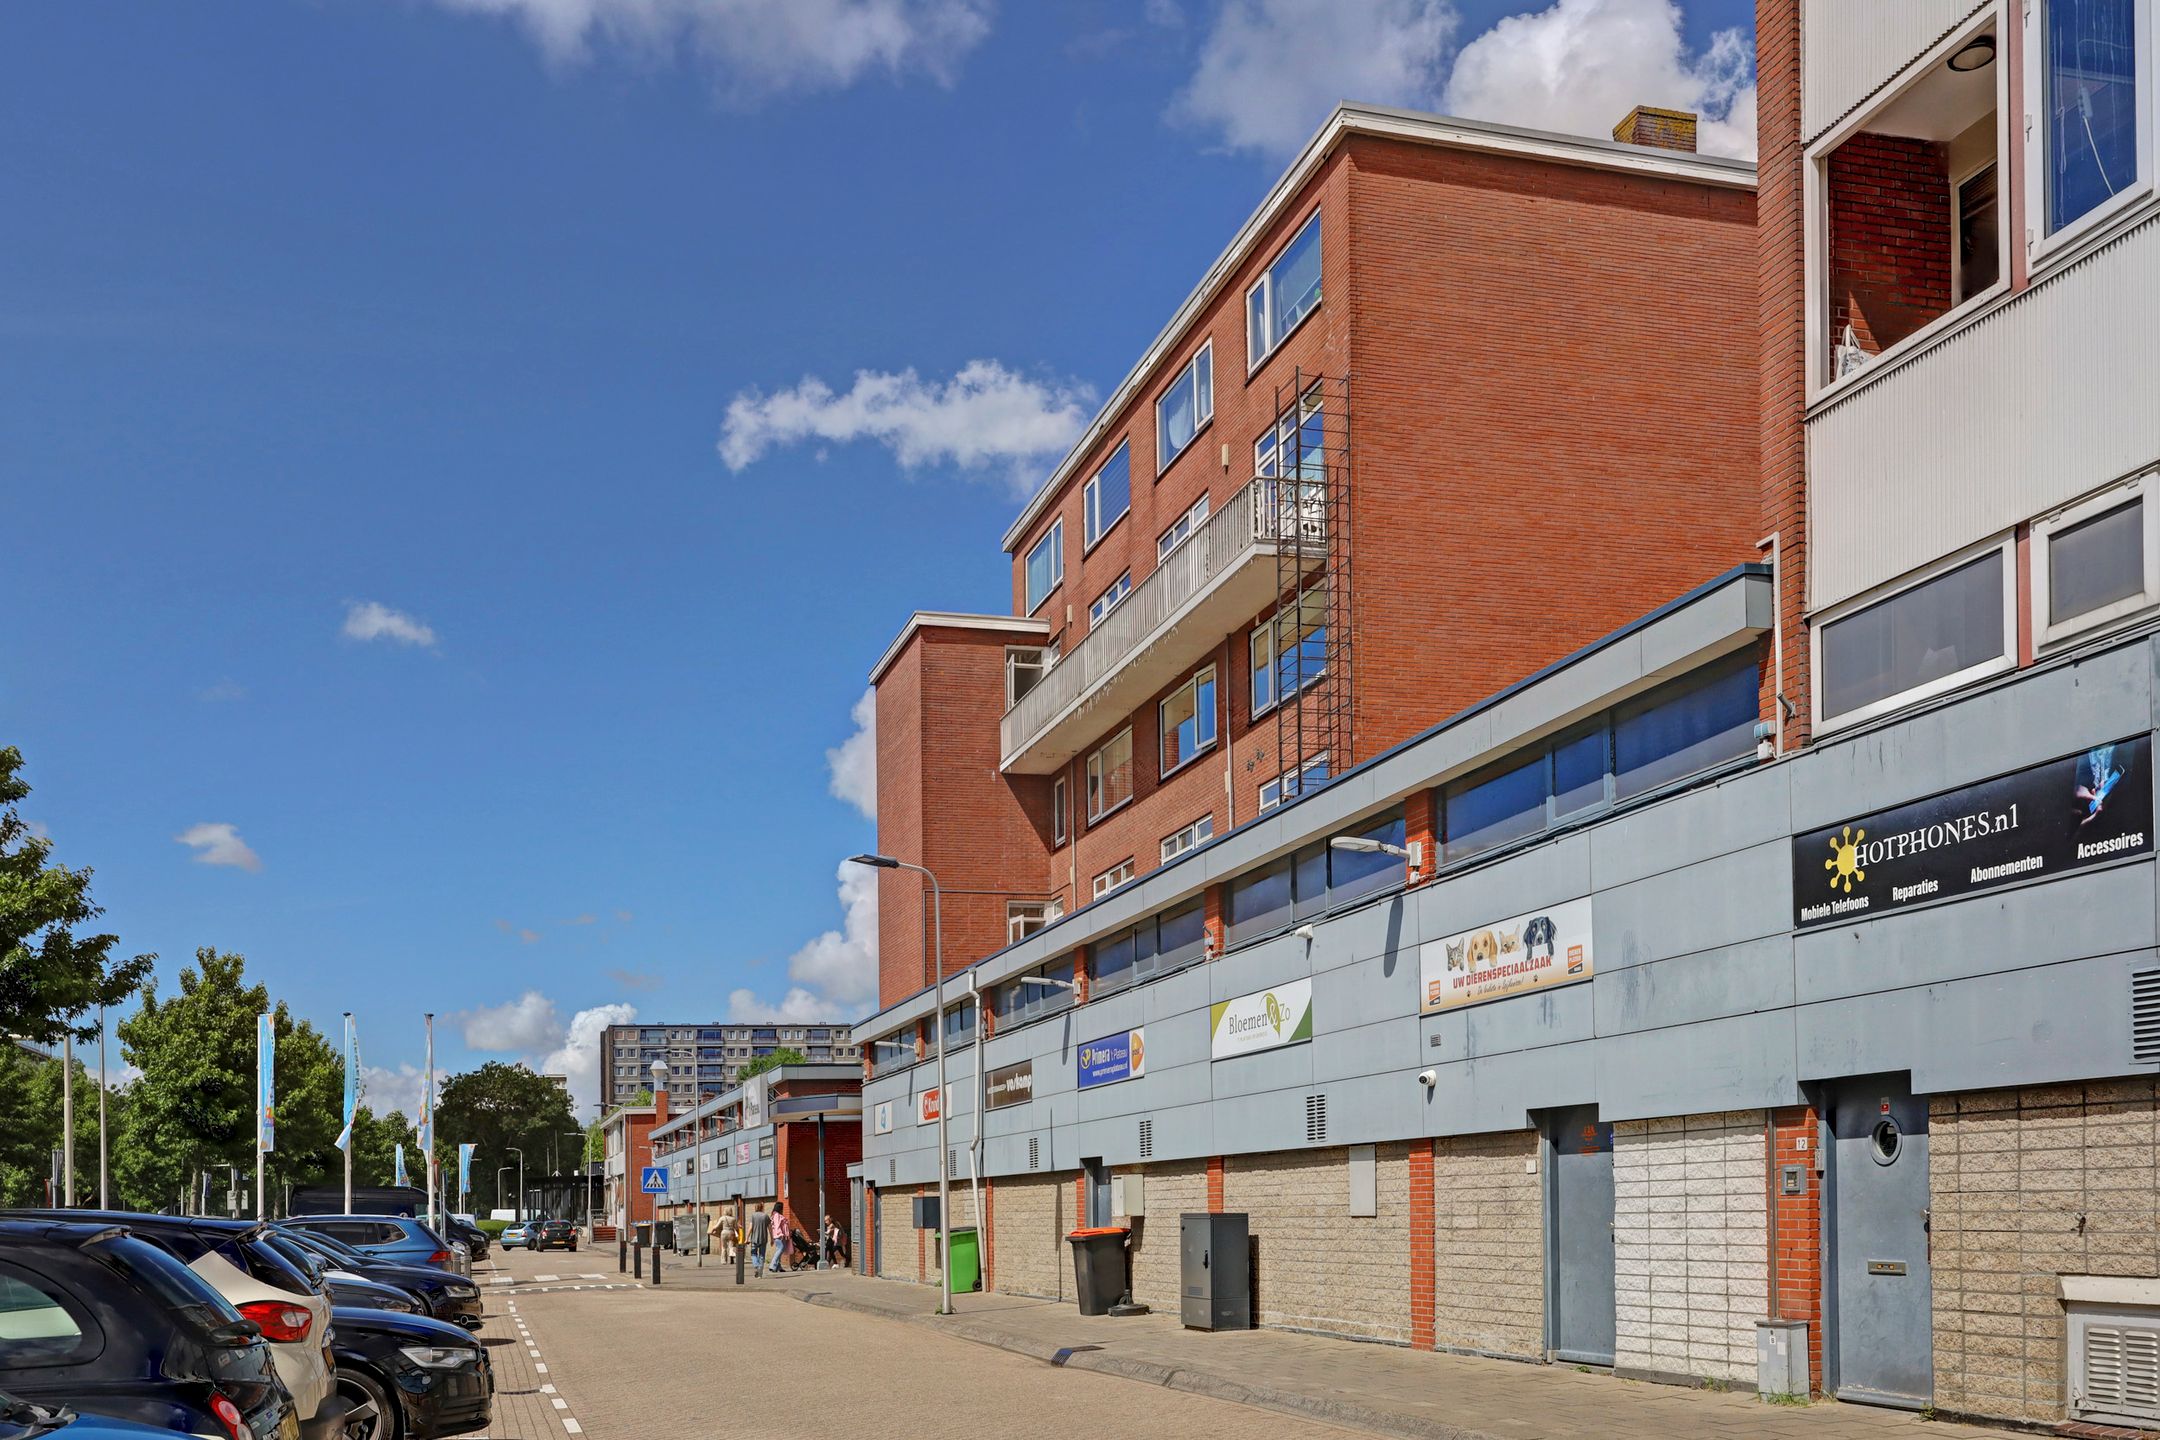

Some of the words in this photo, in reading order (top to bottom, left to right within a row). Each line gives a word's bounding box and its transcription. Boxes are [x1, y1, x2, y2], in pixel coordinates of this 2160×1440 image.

[2077, 832, 2144, 859] Accessoires
[1971, 855, 2043, 883] Abonnementen
[1892, 879, 1939, 902] Reparaties
[1801, 904, 1831, 922] Mobiele
[1832, 896, 1869, 915] Telefoons
[1453, 976, 1465, 989] UW
[1466, 955, 1552, 986] DIERENSPECIAALZAAK
[1229, 1013, 1268, 1035] Bloemen
[1279, 1003, 1291, 1022] Zo
[1092, 1048, 1110, 1066] Primera
[1798, 1139, 1806, 1149] 12
